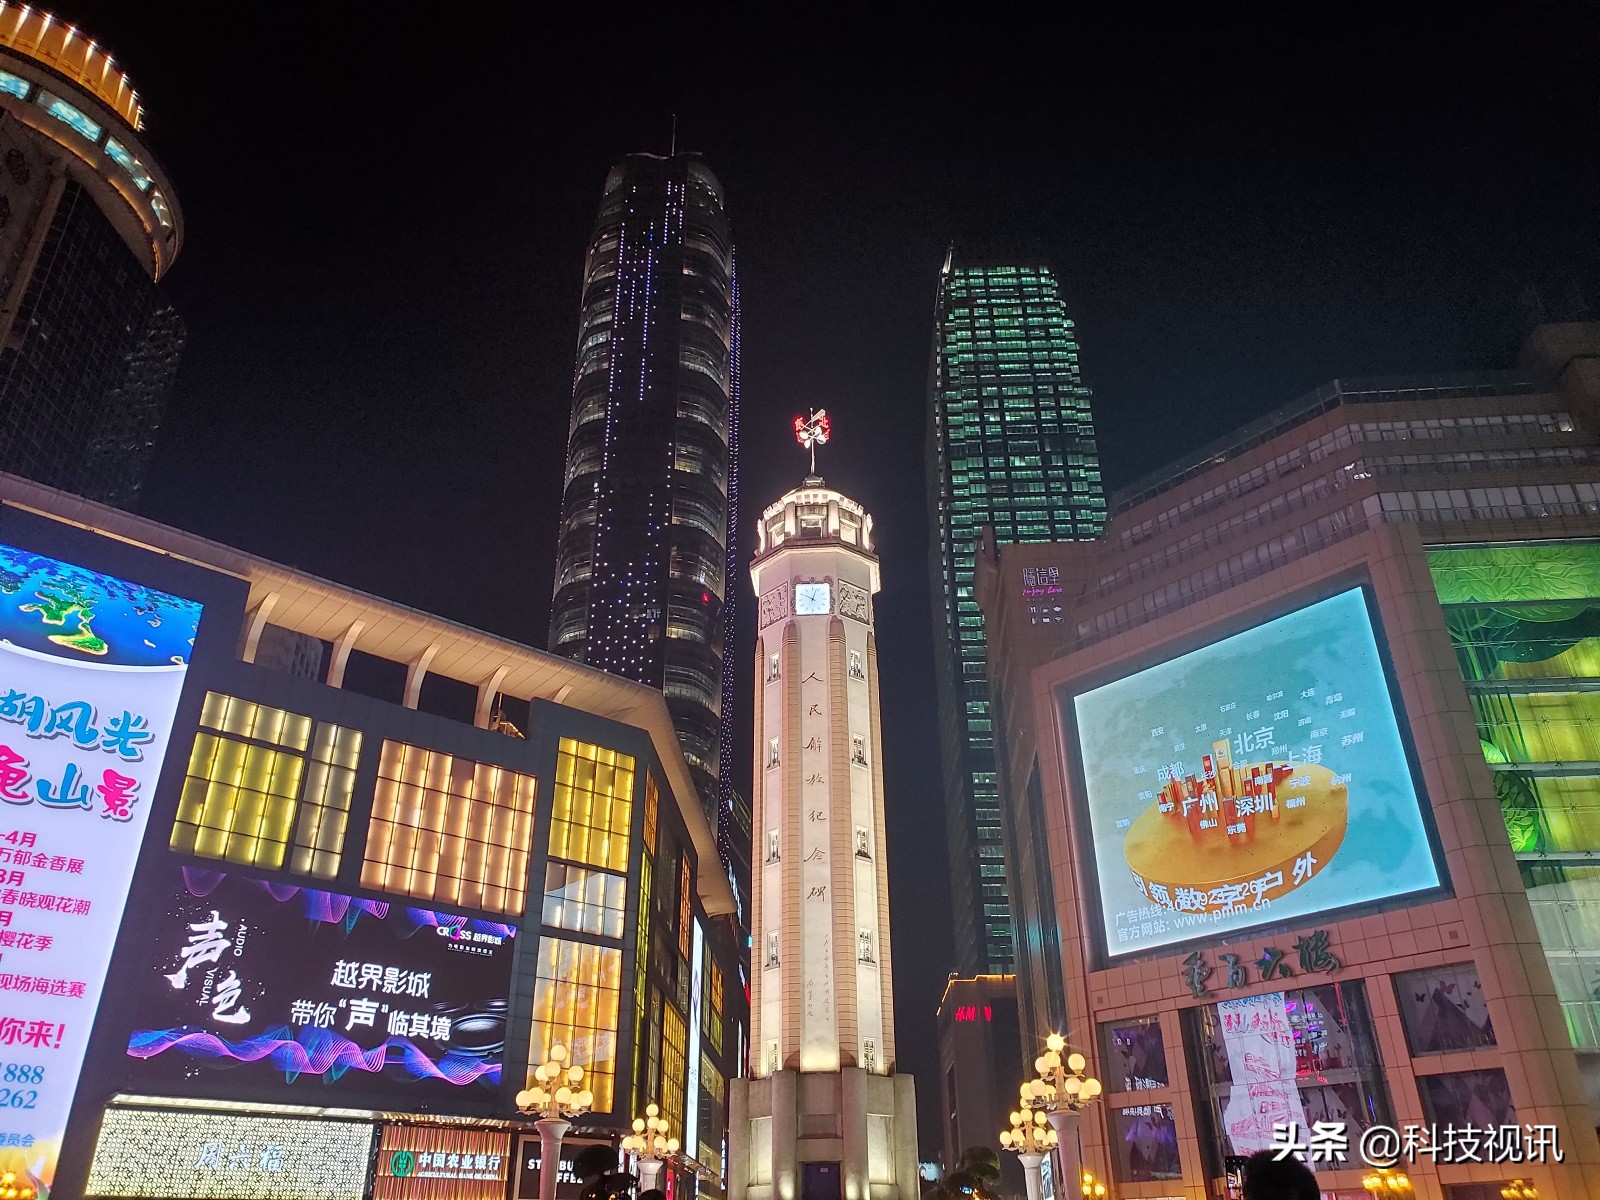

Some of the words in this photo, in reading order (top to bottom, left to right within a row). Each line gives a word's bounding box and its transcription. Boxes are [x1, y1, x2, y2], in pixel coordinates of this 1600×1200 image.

[1273, 709, 1289, 721] 沈阳
[1151, 727, 1164, 737] 西安
[1233, 726, 1275, 755] 北京
[1311, 728, 1328, 739] 南京
[1341, 732, 1364, 747] 苏州
[1271, 744, 1288, 755] 郑州
[1282, 745, 1322, 771] 上海
[1157, 761, 1185, 781] 成都
[1182, 792, 1219, 817] 广州
[1236, 793, 1274, 818] 深圳
[1286, 797, 1306, 809] 福州
[233, 924, 247, 957] AUDIO
[199, 967, 219, 1006] VISUAL
[331, 958, 432, 998] 越界影城
[418, 1152, 501, 1171] 中国农业银行
